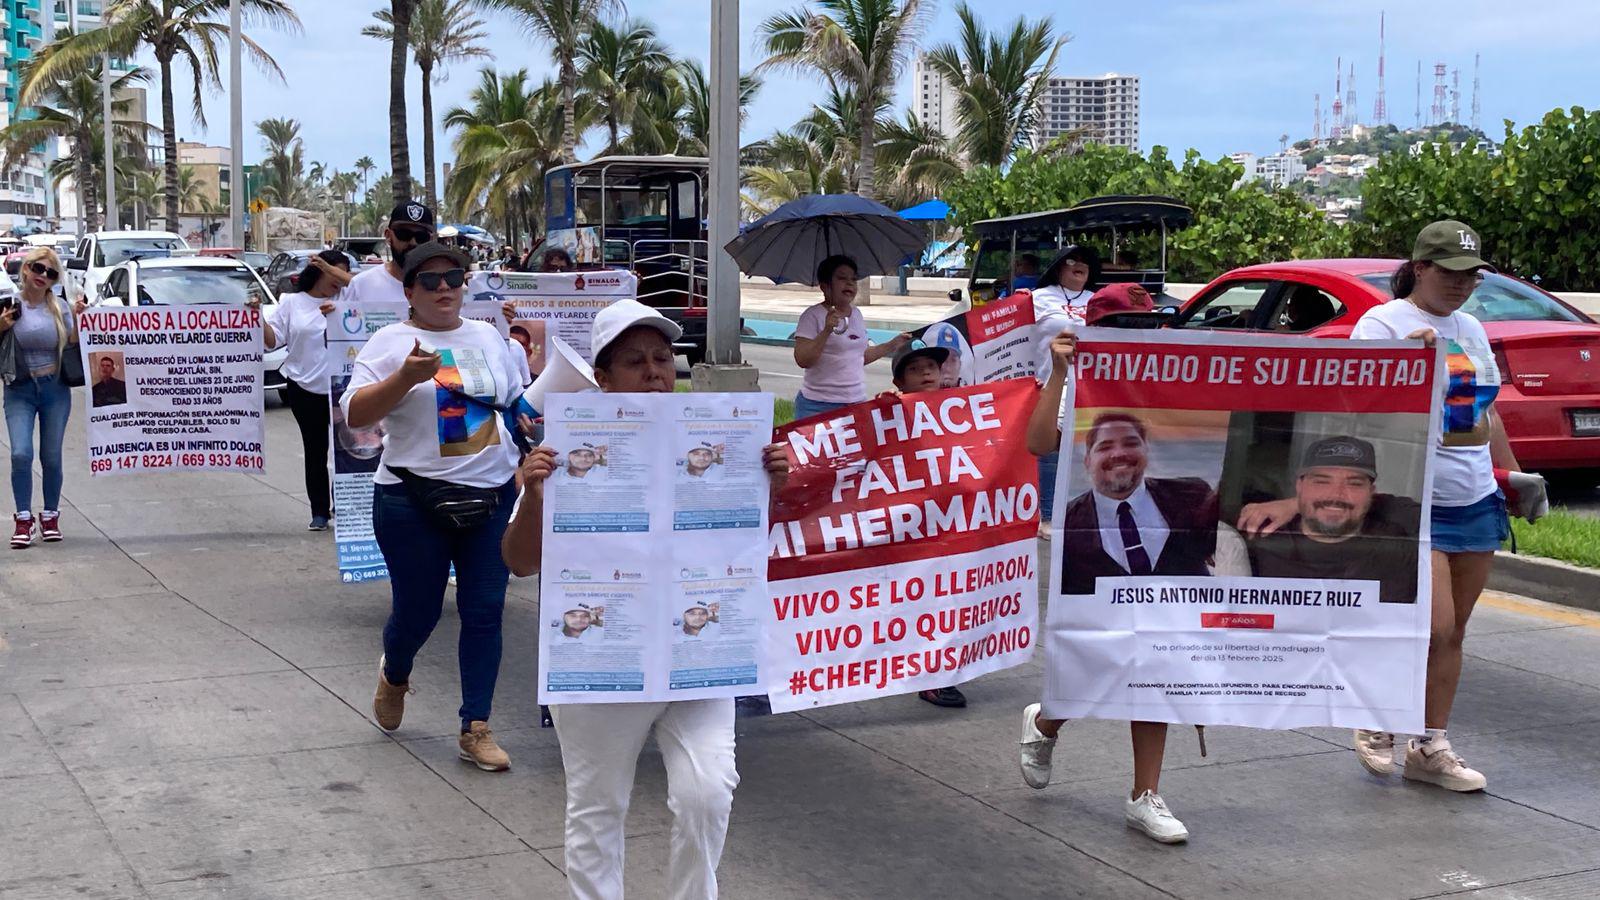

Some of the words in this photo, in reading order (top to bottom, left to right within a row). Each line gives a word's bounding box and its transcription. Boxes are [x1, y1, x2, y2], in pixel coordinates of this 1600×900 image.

[1457, 230, 1476, 251] LA
[507, 282, 538, 290] Sinaloa
[513, 300, 545, 308] danos
[80, 311, 160, 332] AYUDANOS
[165, 312, 175, 330] A
[179, 310, 261, 330] LOCALIZAR
[982, 313, 990, 323] MI
[992, 305, 1018, 319] FAMILIA
[87, 334, 116, 345] JESÚS
[118, 334, 168, 345] SALVADOR
[170, 333, 212, 344] VELARDE
[214, 332, 252, 343] GUERRA
[985, 326, 995, 336] ME
[125, 356, 175, 365] DESAPARECIÓ
[188, 356, 213, 364] LOMAS
[226, 354, 263, 363] MAZATLÁN
[1077, 351, 1200, 383] PRIVADO
[1208, 356, 1246, 385] DE
[1253, 357, 1291, 386] SU
[1298, 358, 1427, 388] LIBERTAD
[189, 377, 213, 385] LUNES
[223, 376, 234, 384] DE
[235, 375, 255, 383] JUNIO
[203, 387, 213, 395] SU
[214, 386, 252, 394] PARADERO
[172, 398, 192, 406] EDAD
[203, 396, 222, 405] AÑOS
[91, 412, 134, 423] CUALQUIER
[136, 410, 189, 419] INFORMACIÓN
[214, 409, 249, 418] ANÓNIMA
[113, 420, 156, 428] BUSCAMOS
[189, 426, 212, 434] CASA.
[787, 414, 862, 467] ME
[871, 392, 1002, 447] HACE
[91, 446, 103, 456] TU
[105, 442, 154, 454] AUSENCIA
[156, 441, 169, 451] ES
[172, 441, 185, 450] UN
[188, 440, 228, 451] INFINITO
[230, 441, 262, 453] DOLOR
[91, 460, 112, 472] 669
[119, 456, 138, 469] 147
[143, 454, 173, 467] 8224
[182, 455, 205, 466] 669
[209, 454, 231, 466] 933
[235, 455, 263, 469] 4610
[832, 446, 984, 504] FALTA
[768, 521, 807, 559] MI
[819, 483, 1039, 553] HERMANO
[773, 589, 841, 621] VIVO
[850, 584, 881, 610] SE
[890, 577, 925, 604] LO
[934, 554, 1034, 599] LLEVARON,
[1111, 588, 1155, 605] JESUS
[1159, 588, 1225, 604] ANTONIO
[1228, 588, 1323, 607] HERNANDEZ
[1326, 590, 1362, 608] RUIZ
[796, 624, 863, 656] VIVO
[873, 618, 907, 645] LO
[916, 592, 1022, 642] QUEREMOS
[1153, 644, 1167, 652] fue
[1170, 644, 1201, 652] privado
[1225, 644, 1260, 652] libertad
[1272, 646, 1325, 654] madrugada
[789, 626, 1032, 696] #CHEFJESUSANTONIO
